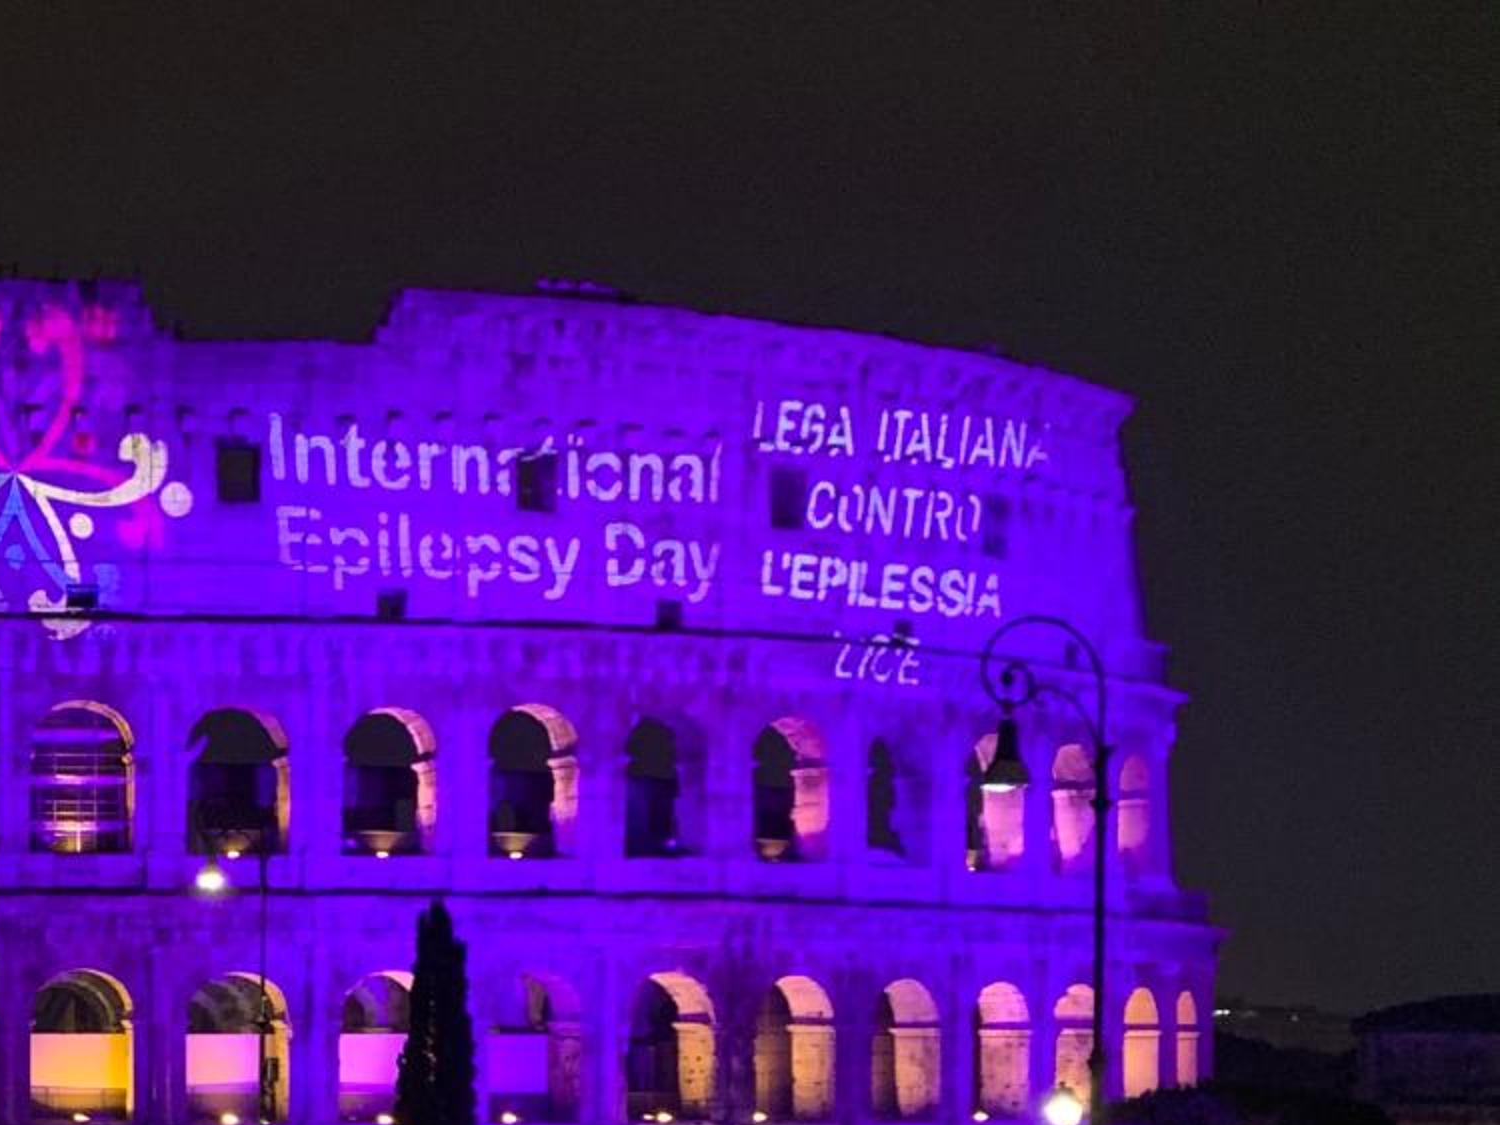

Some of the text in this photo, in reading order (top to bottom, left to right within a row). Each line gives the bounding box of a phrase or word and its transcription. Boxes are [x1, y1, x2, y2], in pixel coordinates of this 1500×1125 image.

[753, 400, 854, 456] LEGA
[806, 481, 981, 541] CONTRO
[276, 505, 720, 603] Epilepsy Day
[761, 550, 1001, 617] L'EPILESSIA
